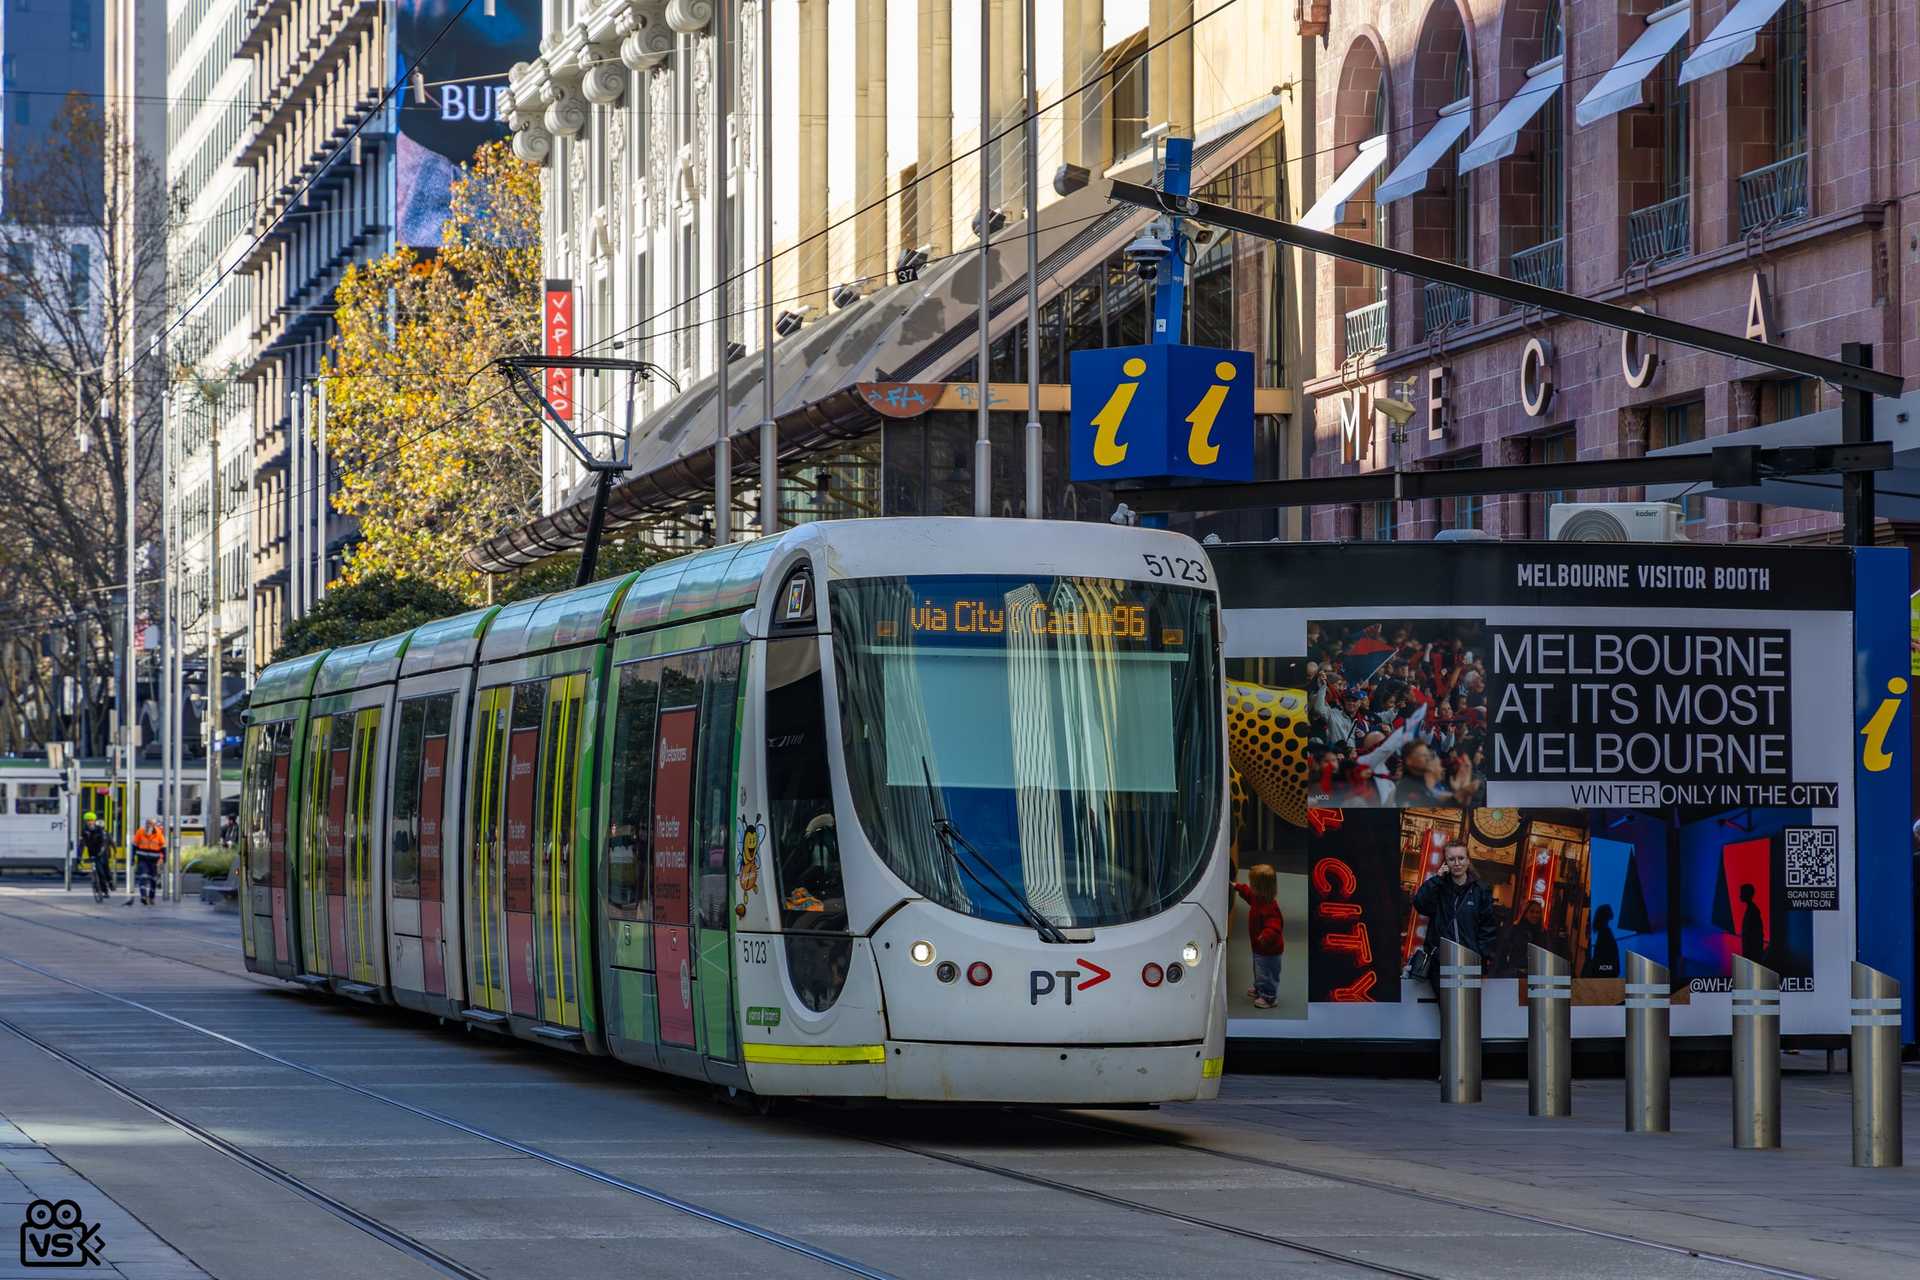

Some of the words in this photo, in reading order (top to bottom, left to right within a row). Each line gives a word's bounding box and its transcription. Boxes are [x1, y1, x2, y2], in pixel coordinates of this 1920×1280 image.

[899, 268, 914, 282] 37
[1142, 553, 1208, 584] 5123
[1517, 563, 1630, 589] MELBOURNE
[1638, 565, 1707, 589] VISITOR
[1714, 567, 1770, 591] BOOTH
[911, 600, 948, 632] via
[953, 600, 1005, 633] City
[1493, 633, 1785, 677] MELBOURNE
[1494, 683, 1554, 724] AT
[1571, 683, 1639, 725] ITS
[1655, 684, 1785, 726] MOST
[1493, 733, 1786, 774] MELBOURNE
[1570, 784, 1655, 805] WINTER
[1660, 785, 1718, 805] ONLY
[1722, 785, 1741, 805] IN
[1744, 785, 1787, 805] THE
[1791, 785, 1838, 805] CITY
[1787, 890, 1809, 899] SCAN
[1809, 890, 1820, 899] TO
[1820, 890, 1836, 899] SEE
[1792, 899, 1819, 908] WHATS
[1819, 900, 1831, 908] ON
[1312, 857, 1378, 1003] CITY
[743, 940, 768, 964] 5123
